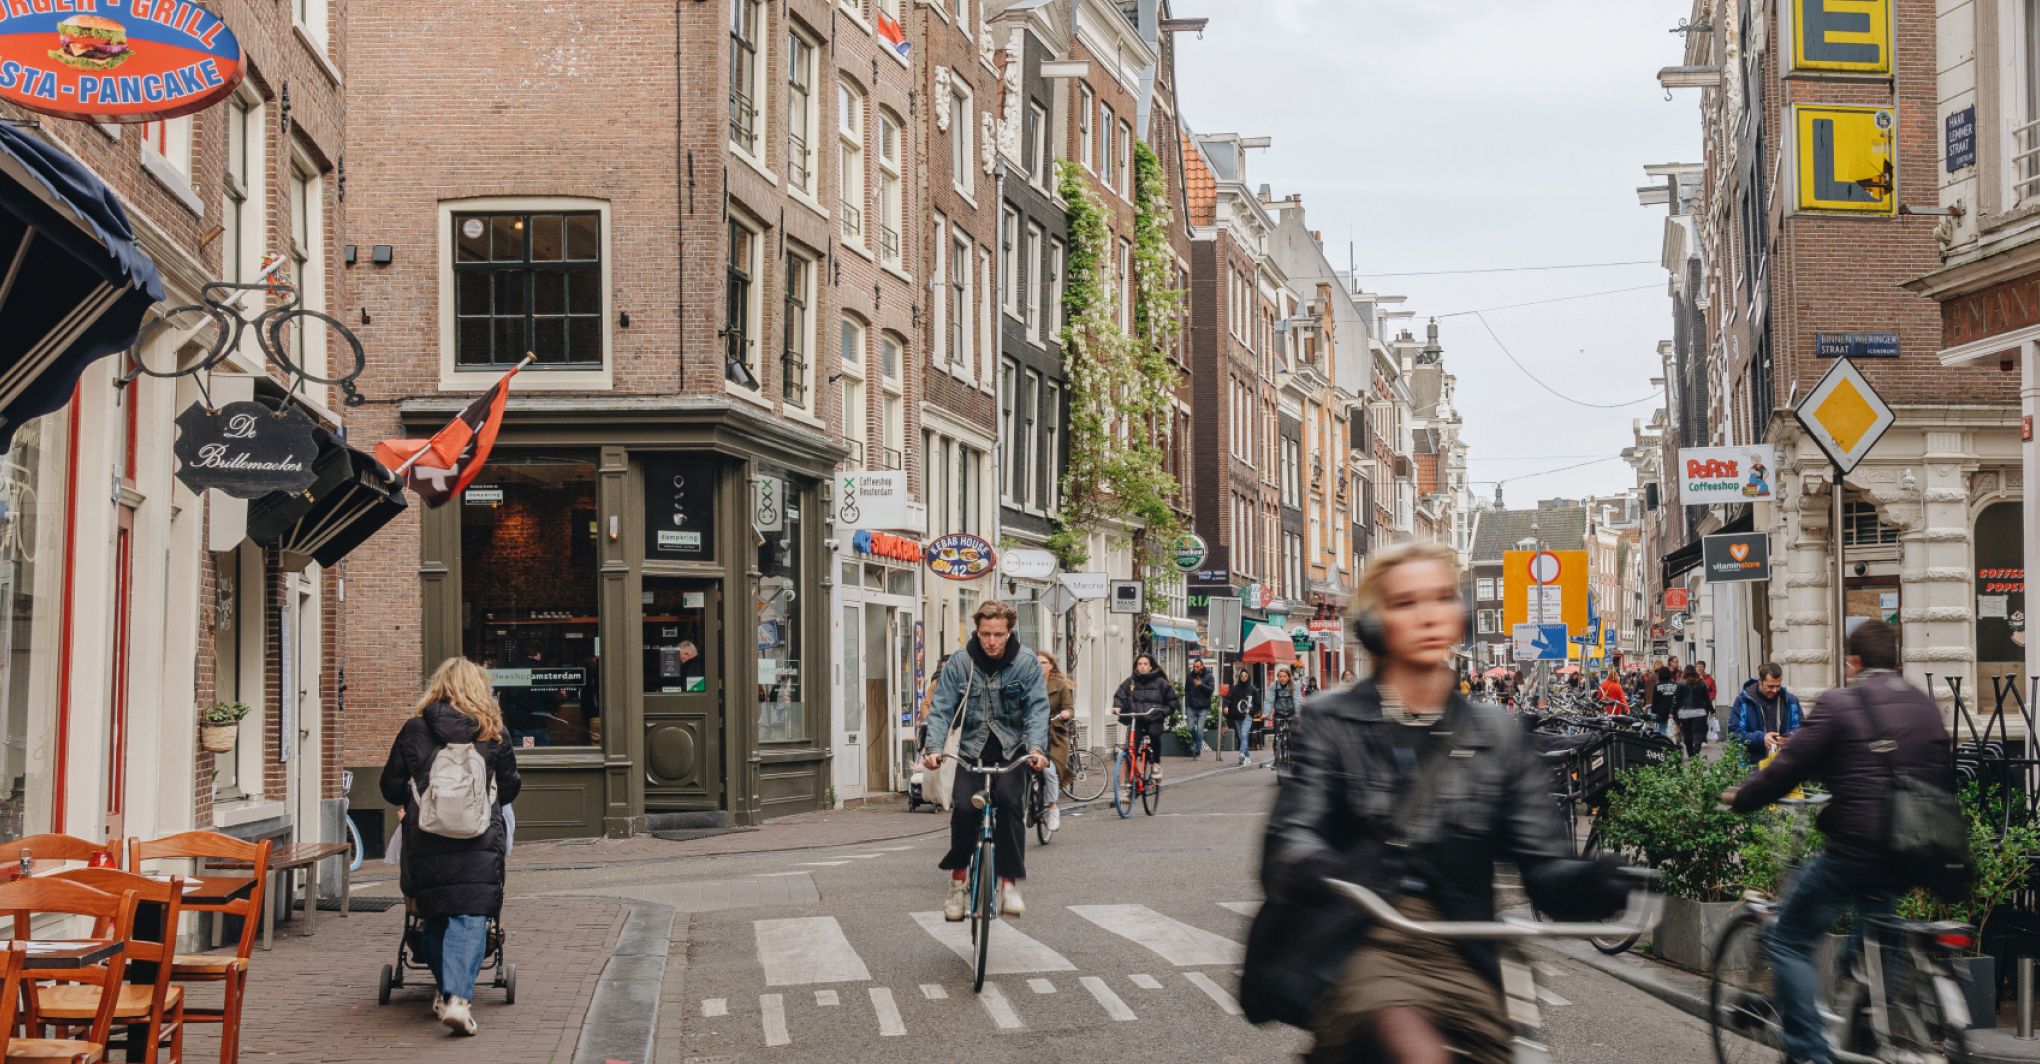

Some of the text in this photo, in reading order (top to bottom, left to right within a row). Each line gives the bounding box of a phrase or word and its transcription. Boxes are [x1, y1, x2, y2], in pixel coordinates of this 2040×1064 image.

[130, 0, 225, 49] GRILL
[1948, 113, 1965, 129] HAAR
[1948, 123, 1973, 144] LEMMER
[1948, 138, 1970, 157] STRAAT
[1821, 335, 1898, 345] BINNEN WIERINGER
[1821, 345, 1849, 354] STRAAT
[223, 413, 260, 439] De
[860, 476, 892, 487] Coffeeshop
[1689, 481, 1739, 492] Coffeeshop
[860, 487, 893, 497] Amsterdam
[930, 537, 960, 555] KEBAB
[959, 536, 990, 556] HOUSE
[951, 564, 968, 577] 42
[1712, 561, 1761, 572] vitaminstore
